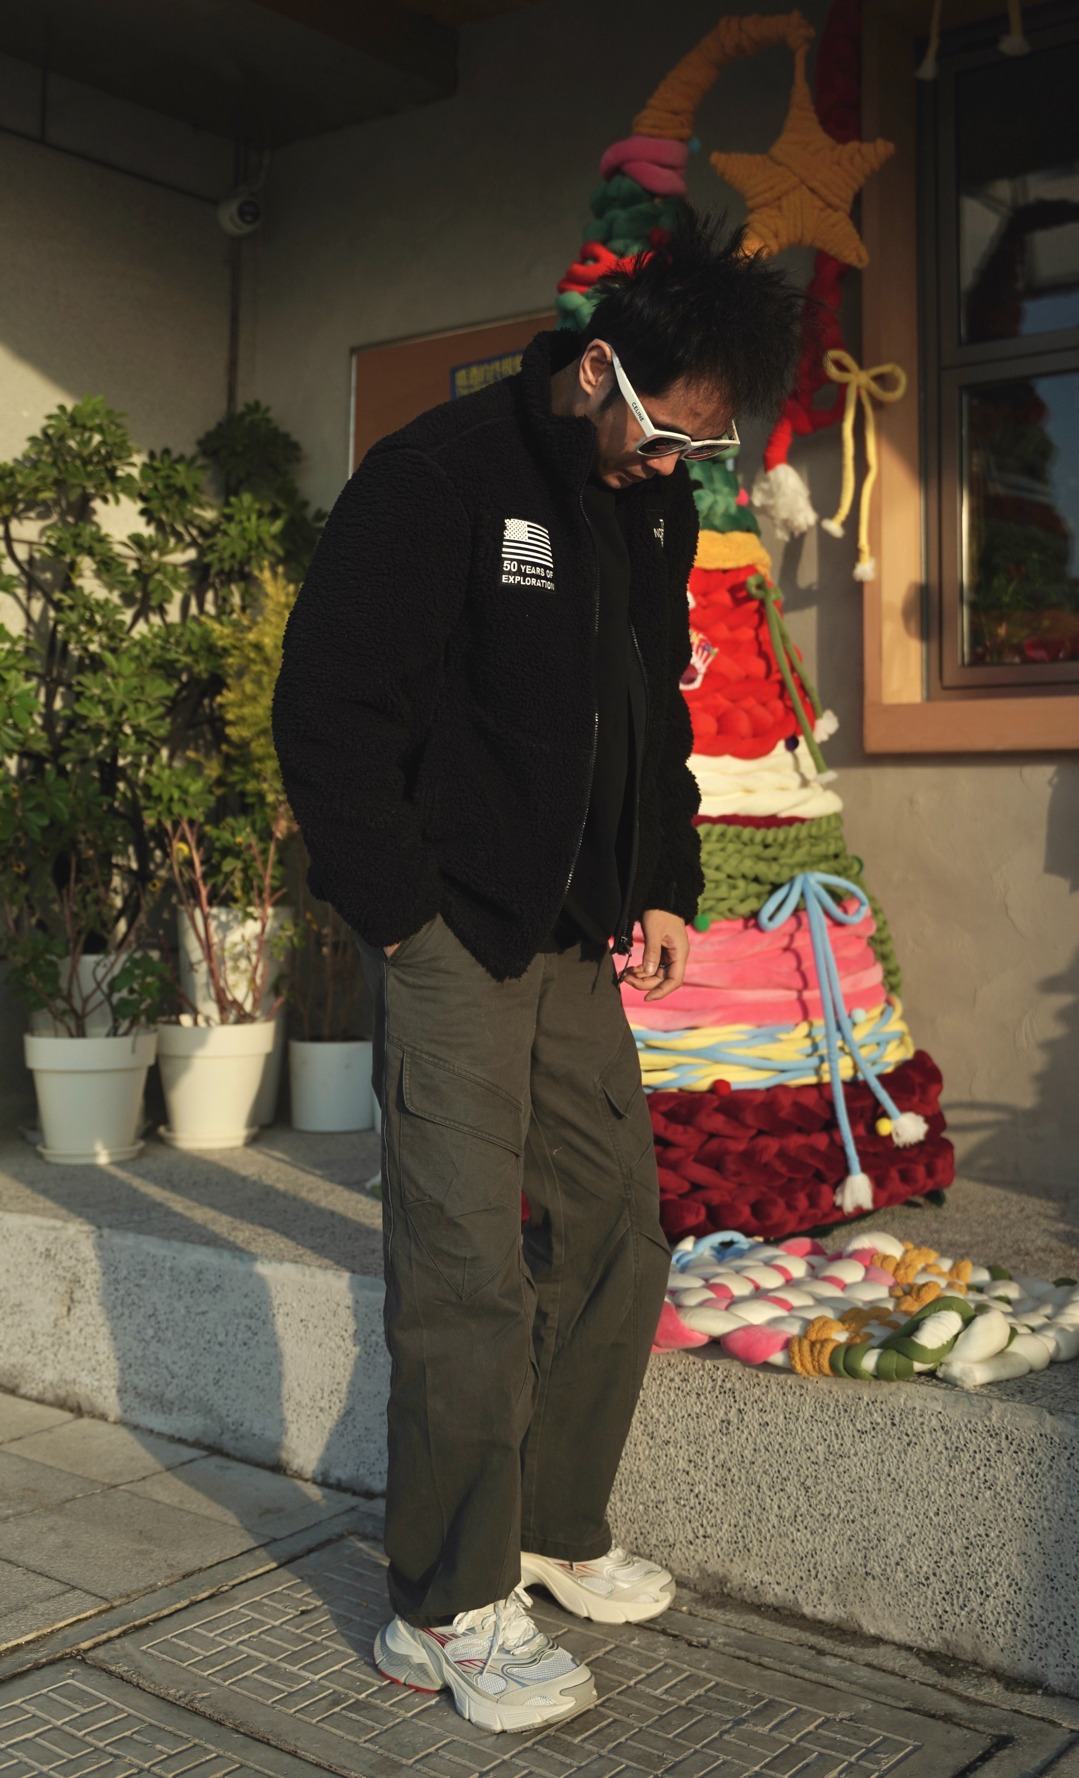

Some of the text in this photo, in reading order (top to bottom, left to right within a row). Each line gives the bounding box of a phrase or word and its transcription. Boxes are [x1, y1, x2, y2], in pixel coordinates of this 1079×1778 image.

[631, 402, 645, 422] CELINE
[502, 560, 554, 579] 50 YEARS OF
[501, 574, 555, 591] EXPLORATION
